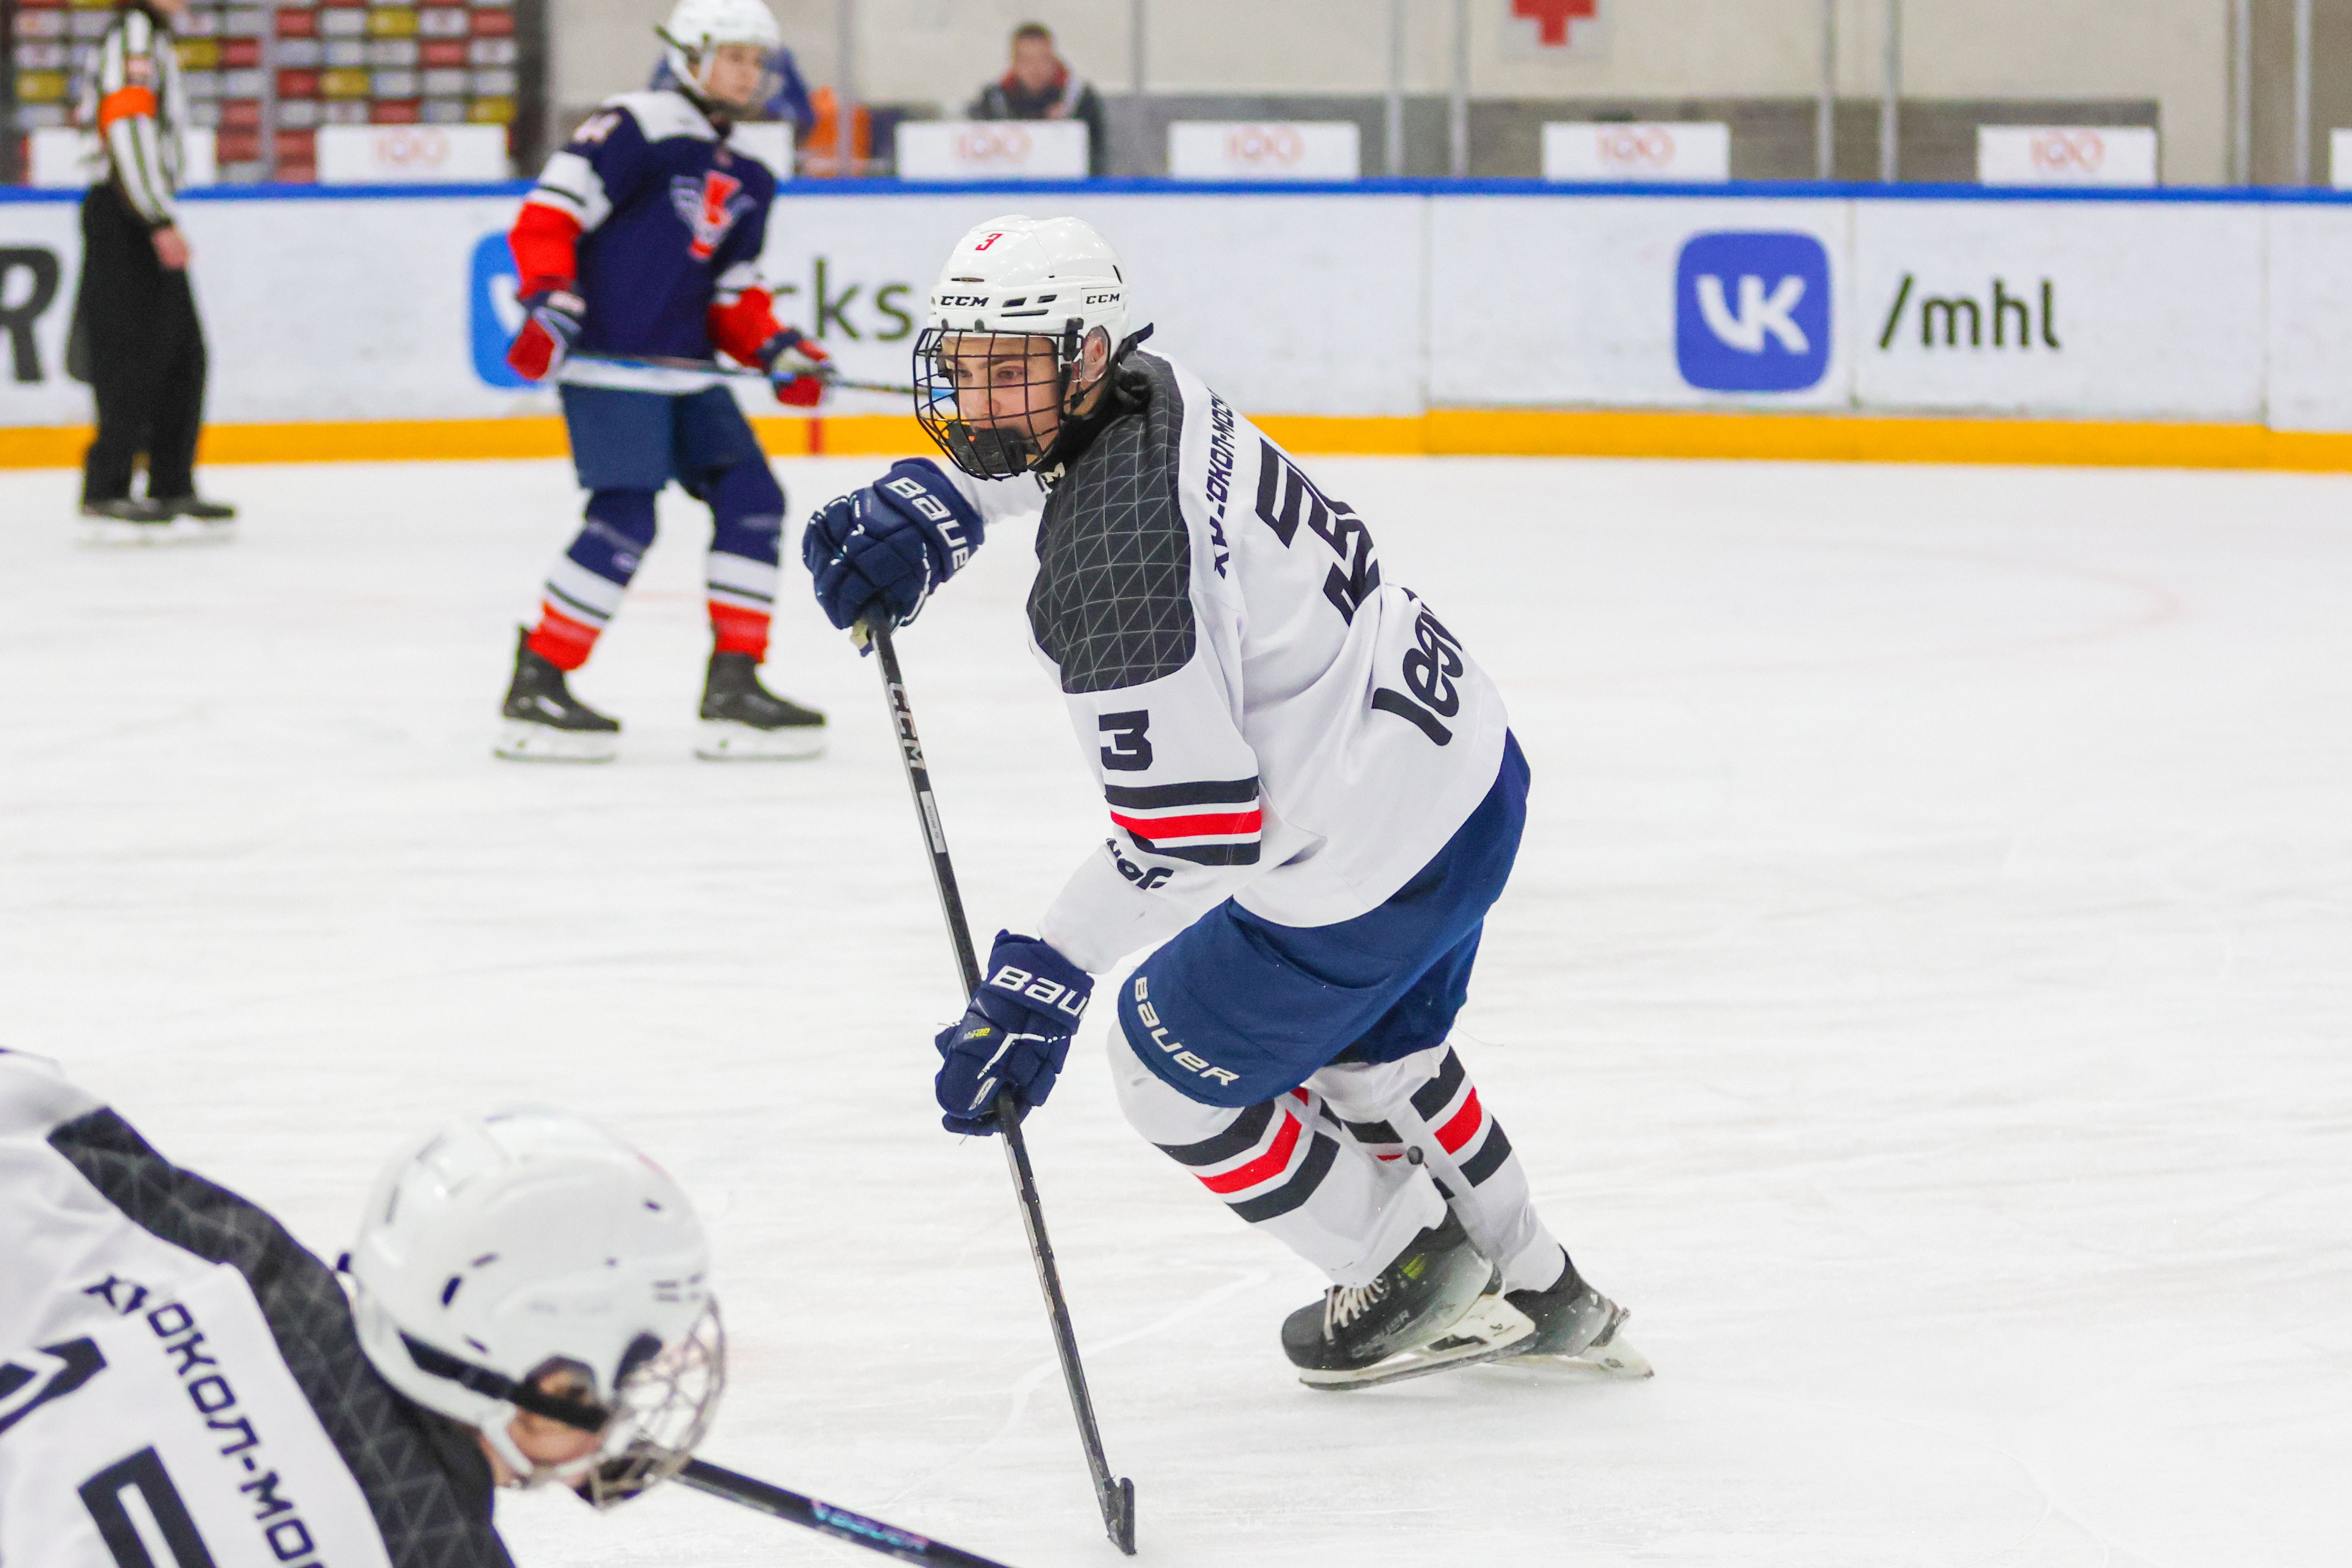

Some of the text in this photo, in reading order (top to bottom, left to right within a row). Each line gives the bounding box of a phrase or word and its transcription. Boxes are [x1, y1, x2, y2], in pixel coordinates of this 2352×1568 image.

[975, 233, 1004, 250] 3
[941, 295, 989, 307] CCM
[1086, 293, 1120, 304] CCM
[1878, 273, 2062, 352] /mhl
[889, 682, 926, 770] CCM
[1099, 710, 1153, 771] 3
